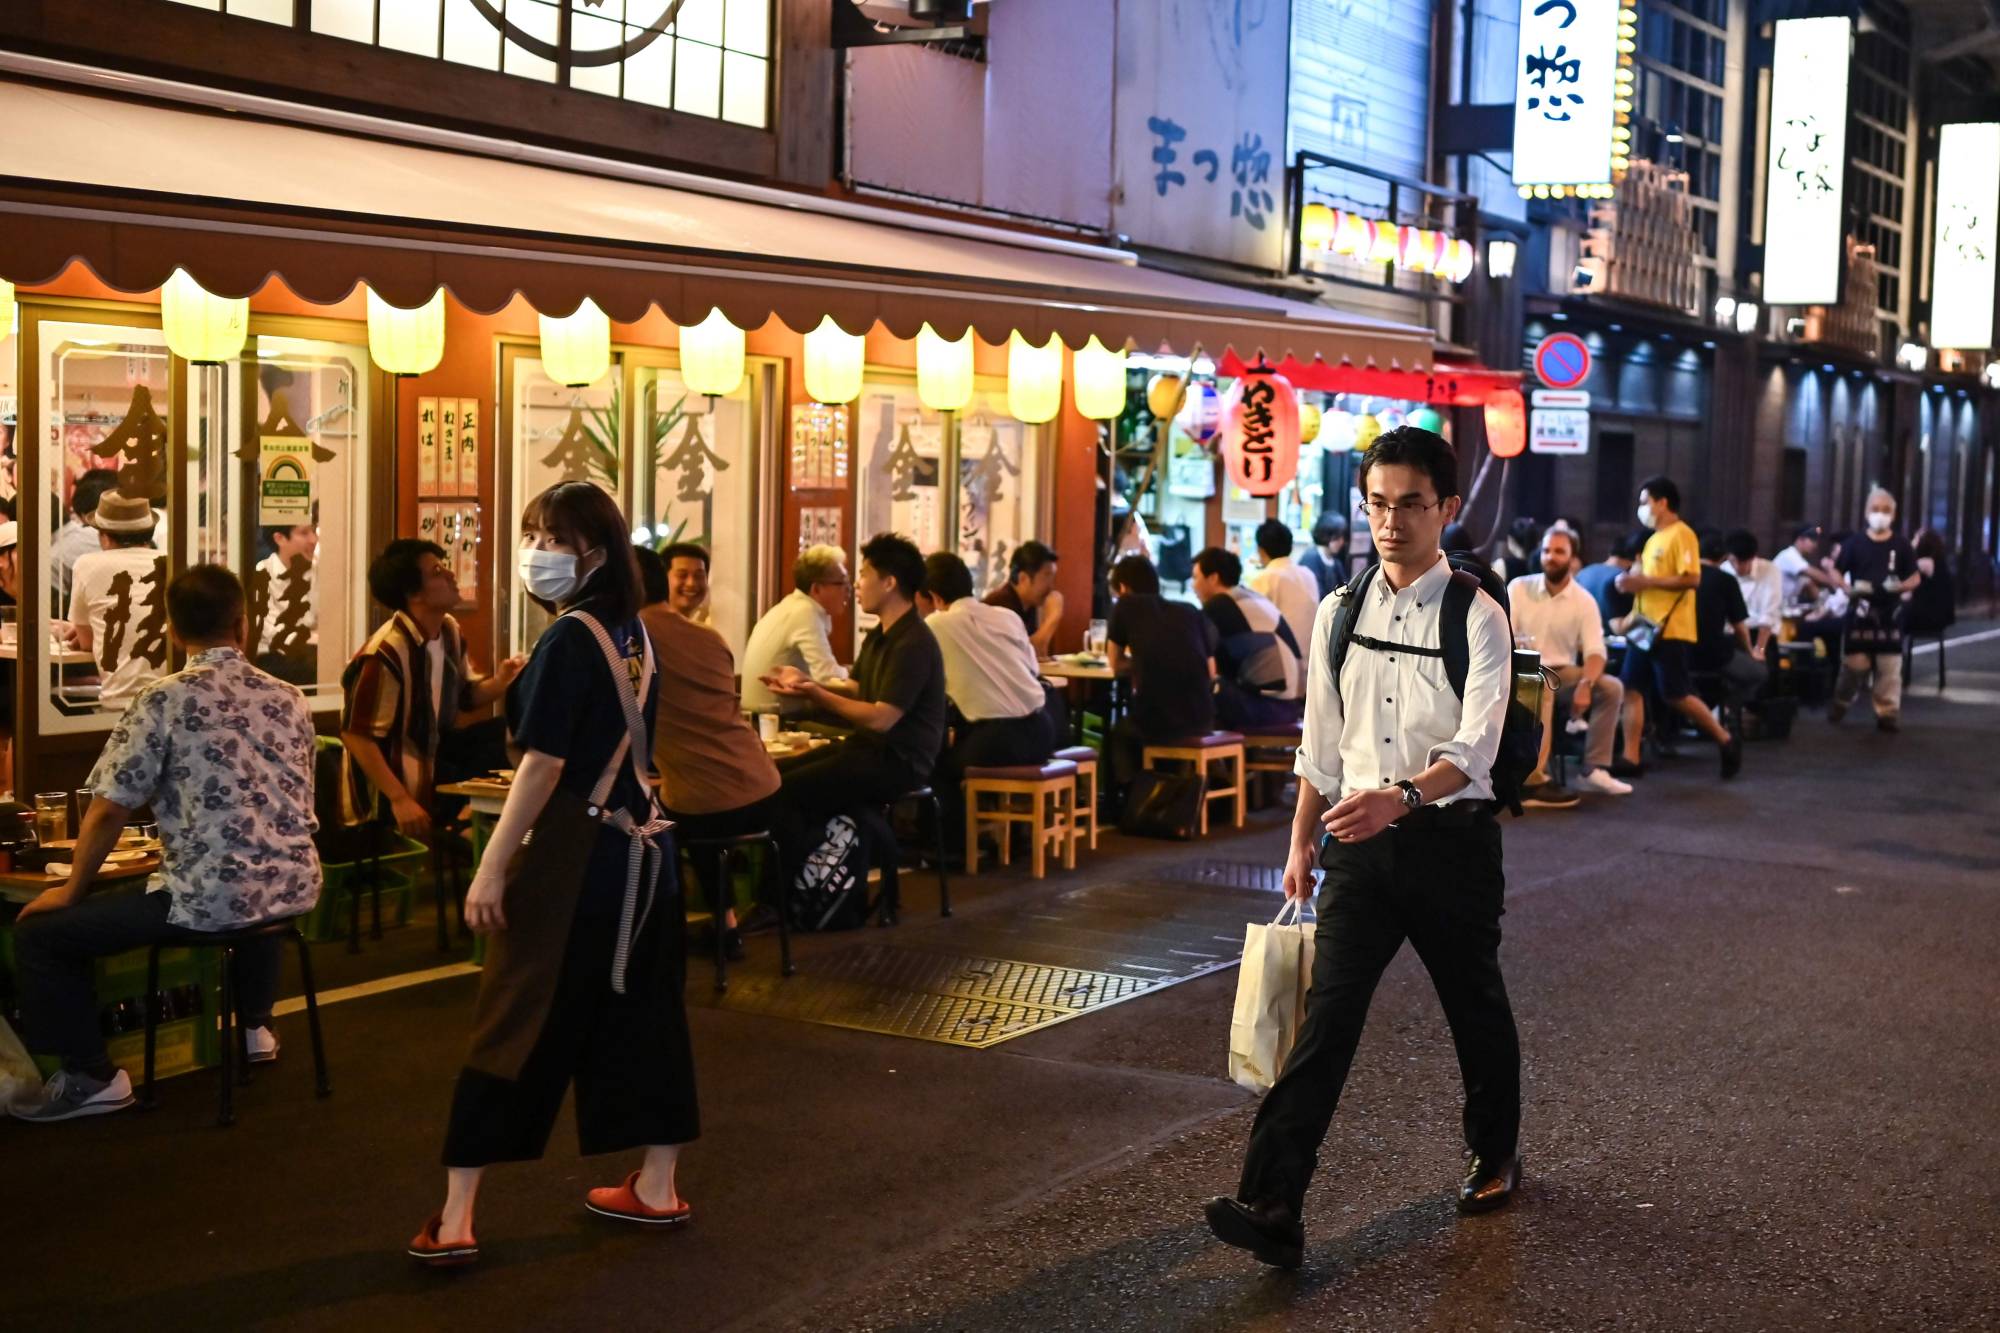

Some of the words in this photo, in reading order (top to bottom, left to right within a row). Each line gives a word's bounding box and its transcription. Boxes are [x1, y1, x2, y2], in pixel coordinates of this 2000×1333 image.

[1526, 0, 1585, 122] つ惣
[1147, 115, 1275, 231] まつ惣
[461, 412, 476, 453] 正肉
[1241, 380, 1276, 481] やきとり
[462, 515, 475, 553] かわ
